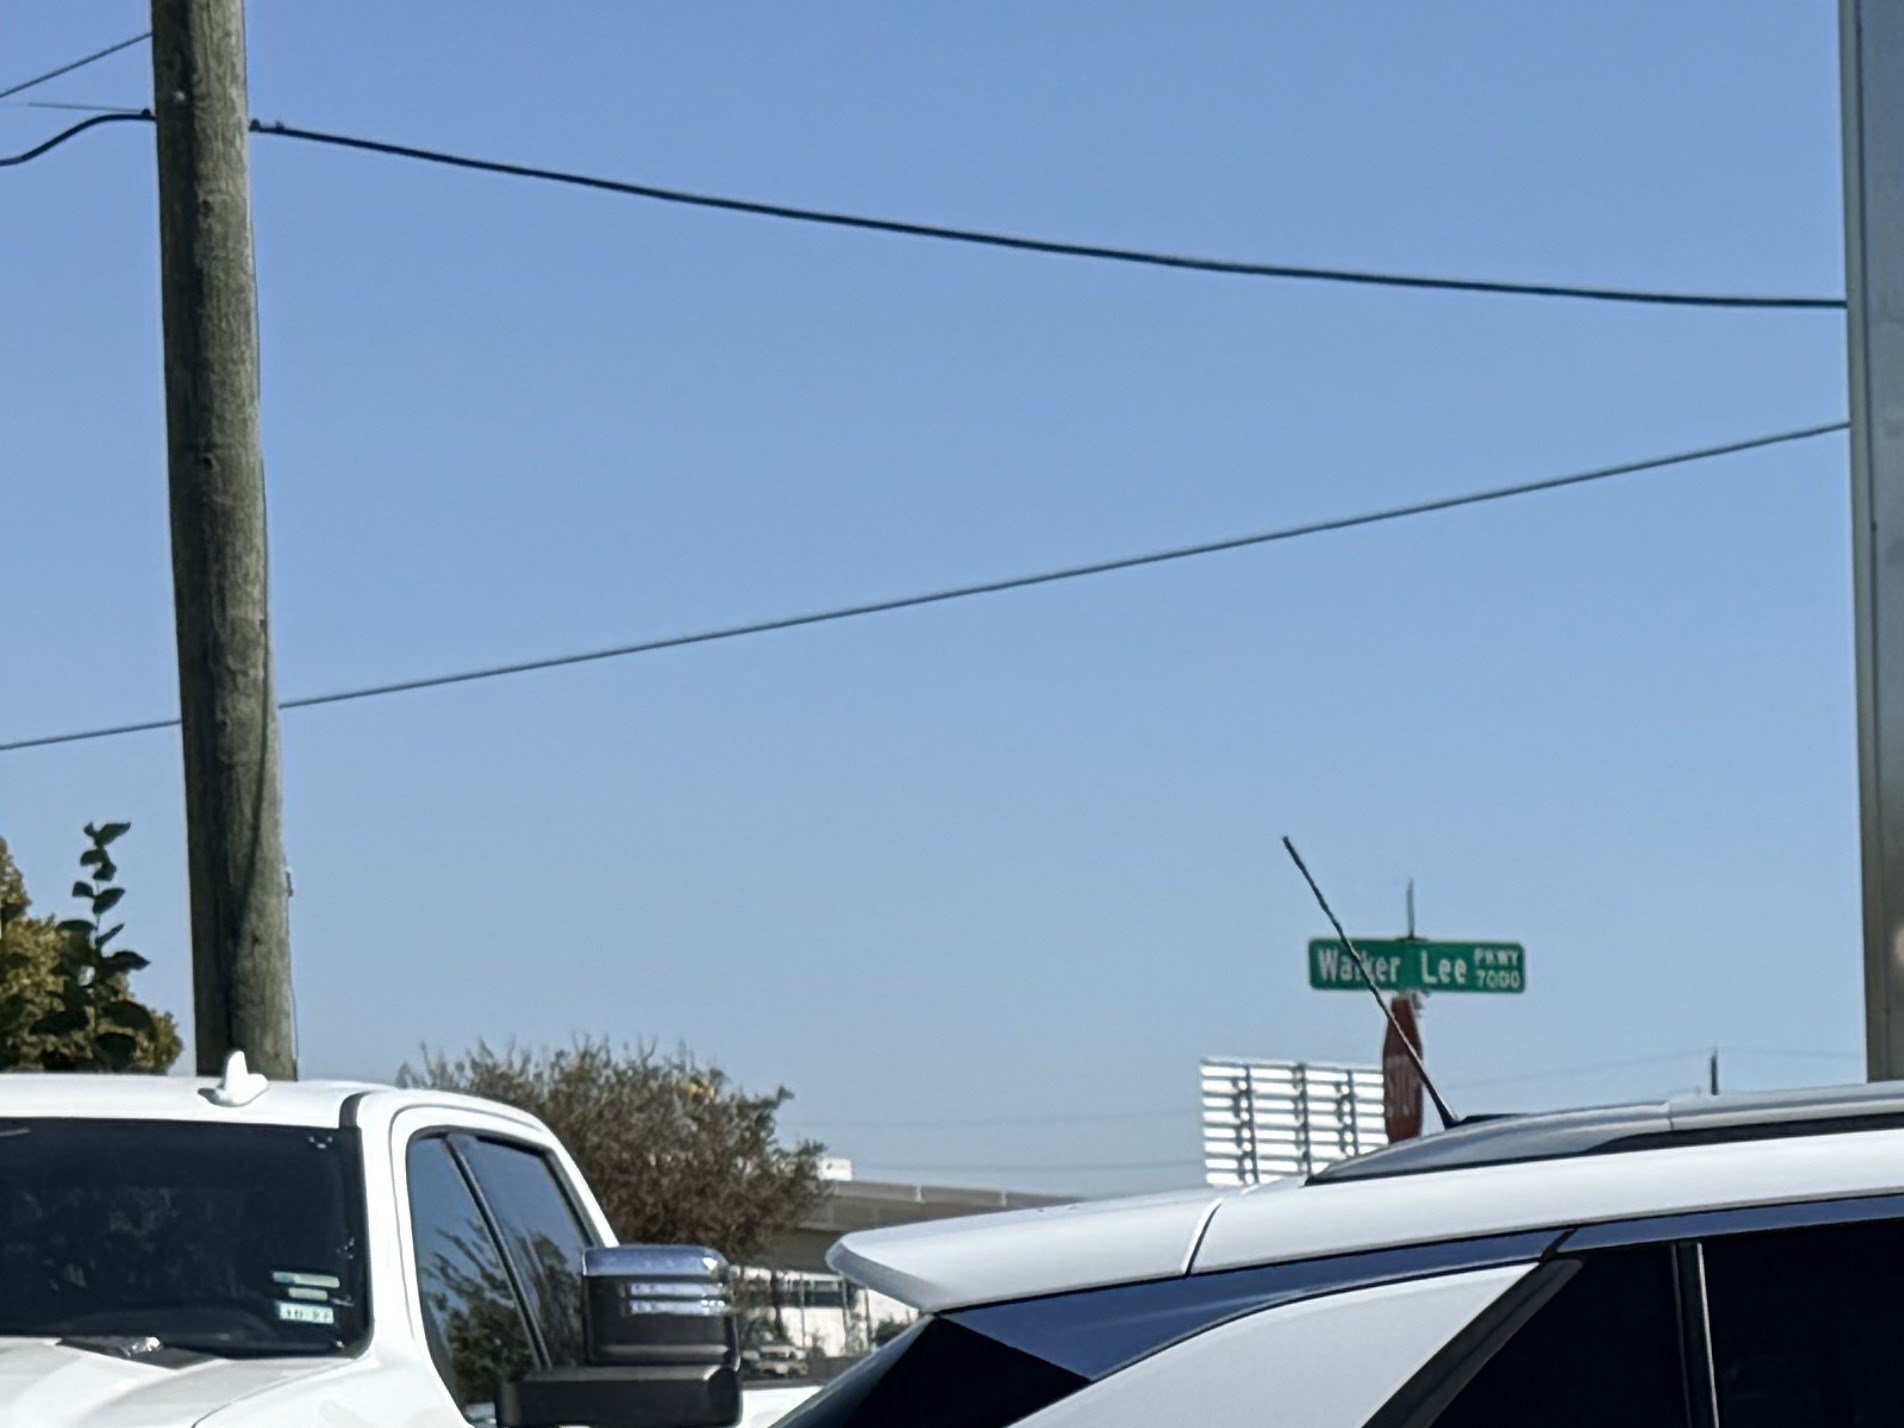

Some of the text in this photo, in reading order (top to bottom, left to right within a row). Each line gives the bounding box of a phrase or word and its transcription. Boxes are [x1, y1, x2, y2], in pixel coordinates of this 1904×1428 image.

[1420, 949, 1468, 985] Lee
[1473, 948, 1519, 967] PKWY
[1475, 968, 1521, 988] 7000
